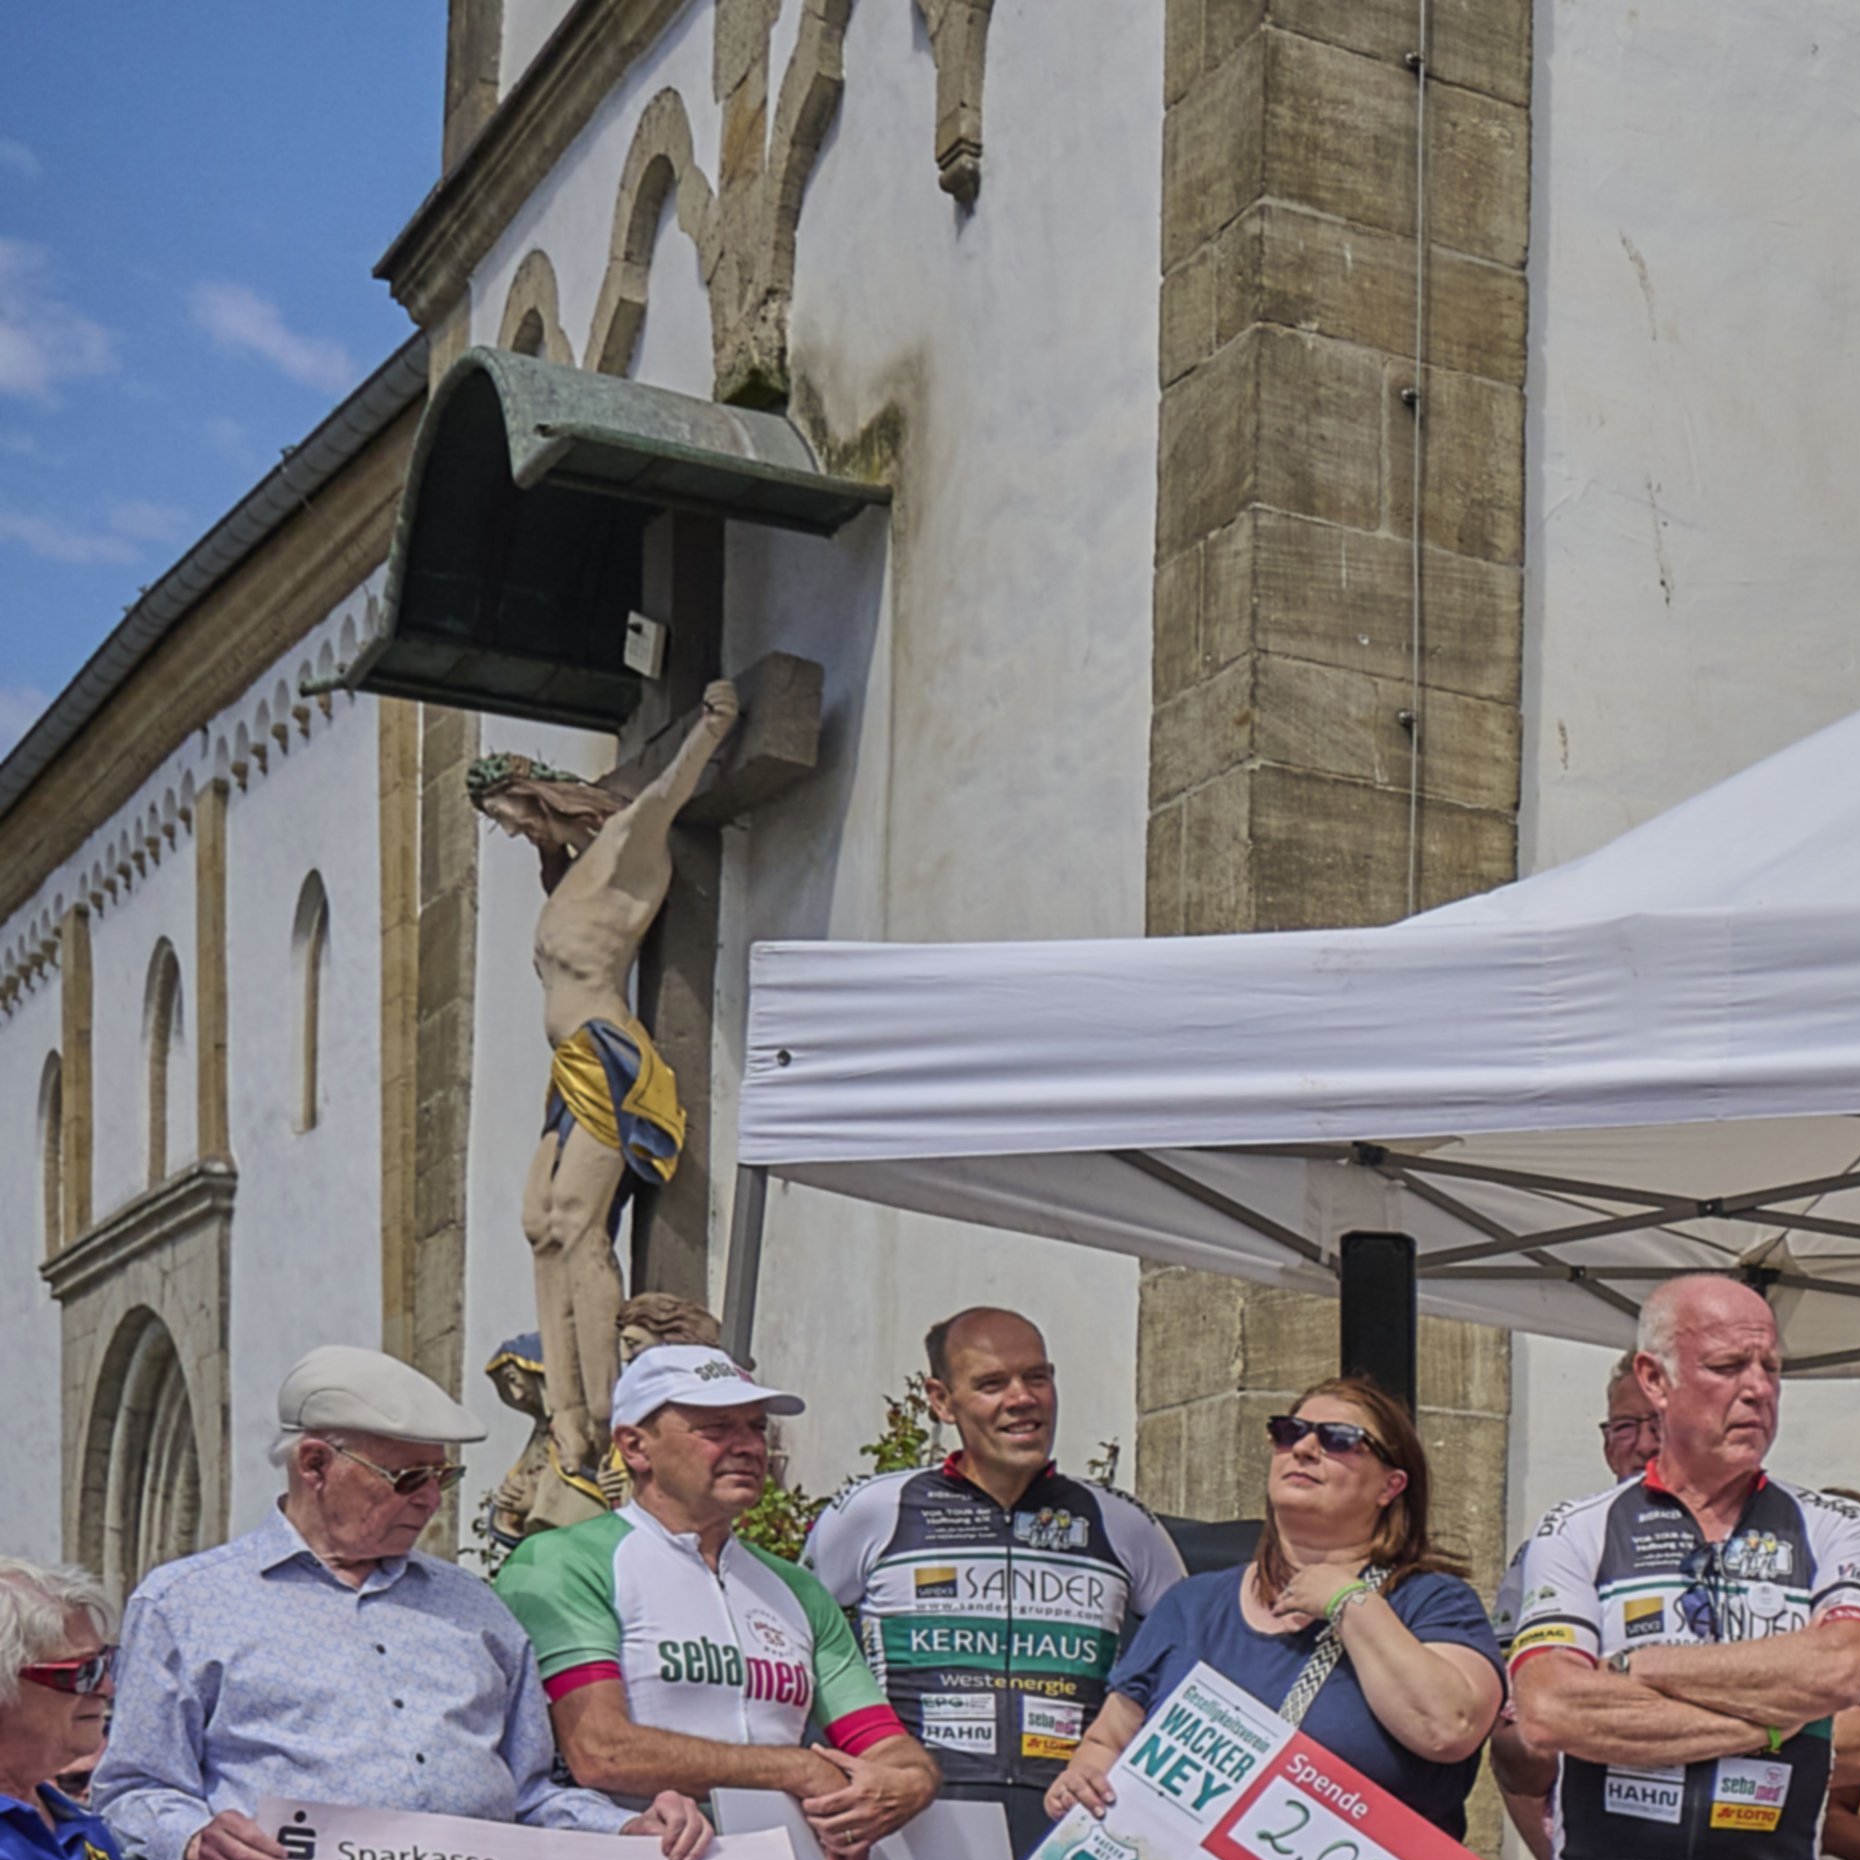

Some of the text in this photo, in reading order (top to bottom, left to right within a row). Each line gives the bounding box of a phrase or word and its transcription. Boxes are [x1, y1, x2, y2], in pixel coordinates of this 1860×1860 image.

[965, 1567, 1104, 1610] SANDER
[911, 1629, 1098, 1663] KERN-HAUS
[658, 1636, 815, 1708] sebamed
[940, 1673, 1077, 1696] westenergie
[925, 1726, 992, 1741] HAHN
[1182, 1684, 1272, 1754] Geselligkeitsverein
[1158, 1702, 1256, 1784] WACKER
[1129, 1735, 1233, 1812] NEY
[1286, 1753, 1369, 1820] Spende
[1721, 1776, 1784, 1801] sebamed
[1608, 1782, 1678, 1807] HAHN
[1736, 1807, 1777, 1822] LOTTO
